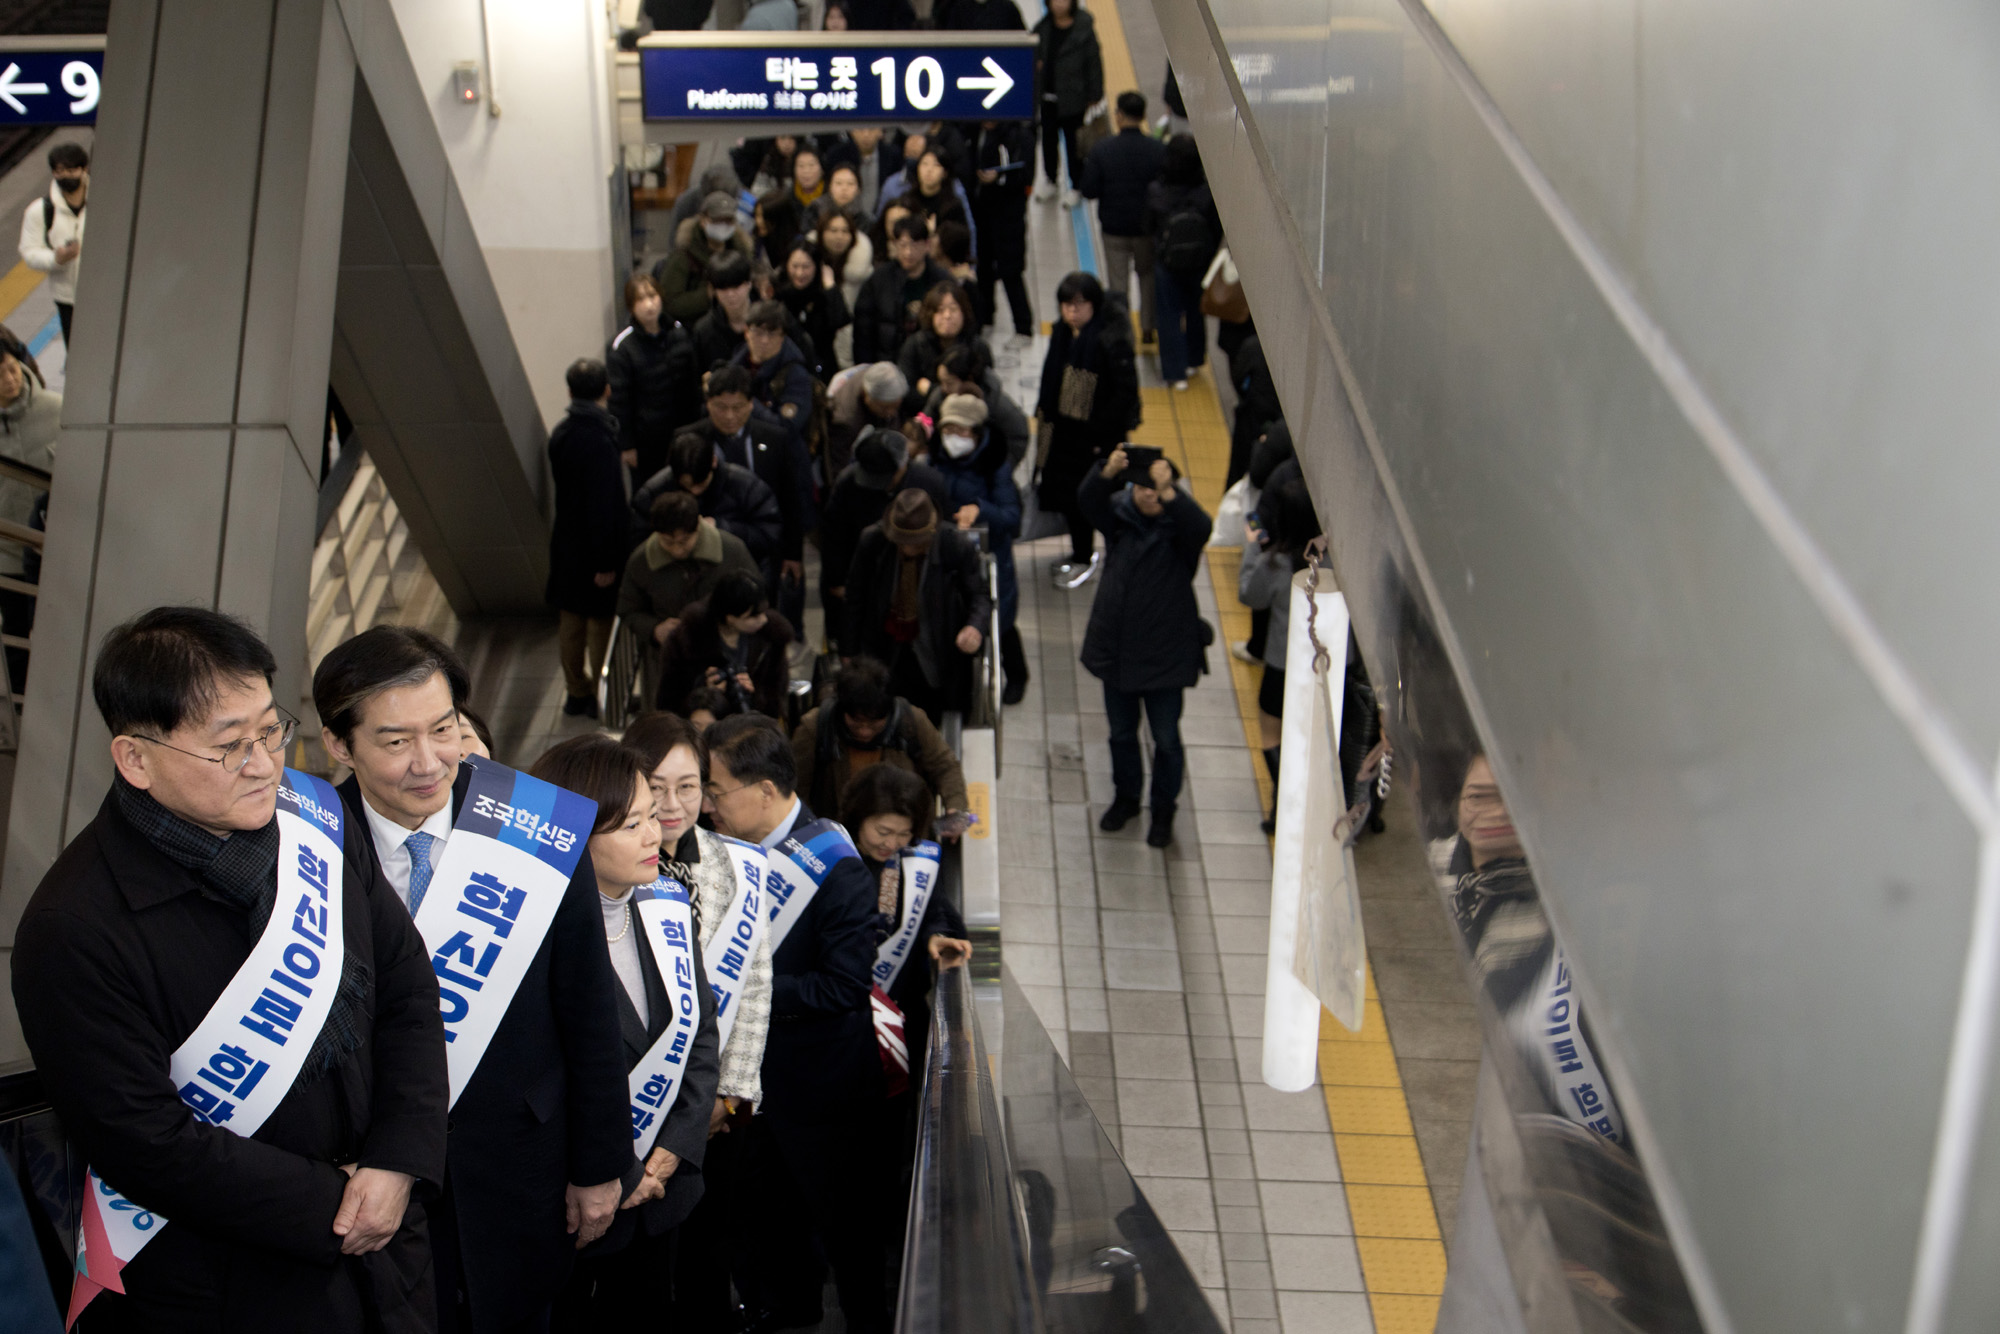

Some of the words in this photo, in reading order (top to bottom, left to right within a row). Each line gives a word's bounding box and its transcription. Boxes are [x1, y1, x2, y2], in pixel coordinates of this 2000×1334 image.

[61, 60, 101, 114] 9
[687, 89, 768, 110] Platforms
[810, 90, 858, 110] のりば
[765, 56, 819, 90] 타는
[830, 56, 858, 90] 곳
[870, 56, 944, 110] 10
[277, 785, 339, 832] 조국혁신당
[472, 794, 577, 853] 조국혁신당
[716, 859, 761, 982] 혁신으로
[765, 869, 797, 923] 혁
[888, 869, 930, 957] 혁신으로
[238, 843, 328, 1047] 혁신으로
[660, 918, 693, 1065] 혁신으로
[872, 959, 897, 986] 희
